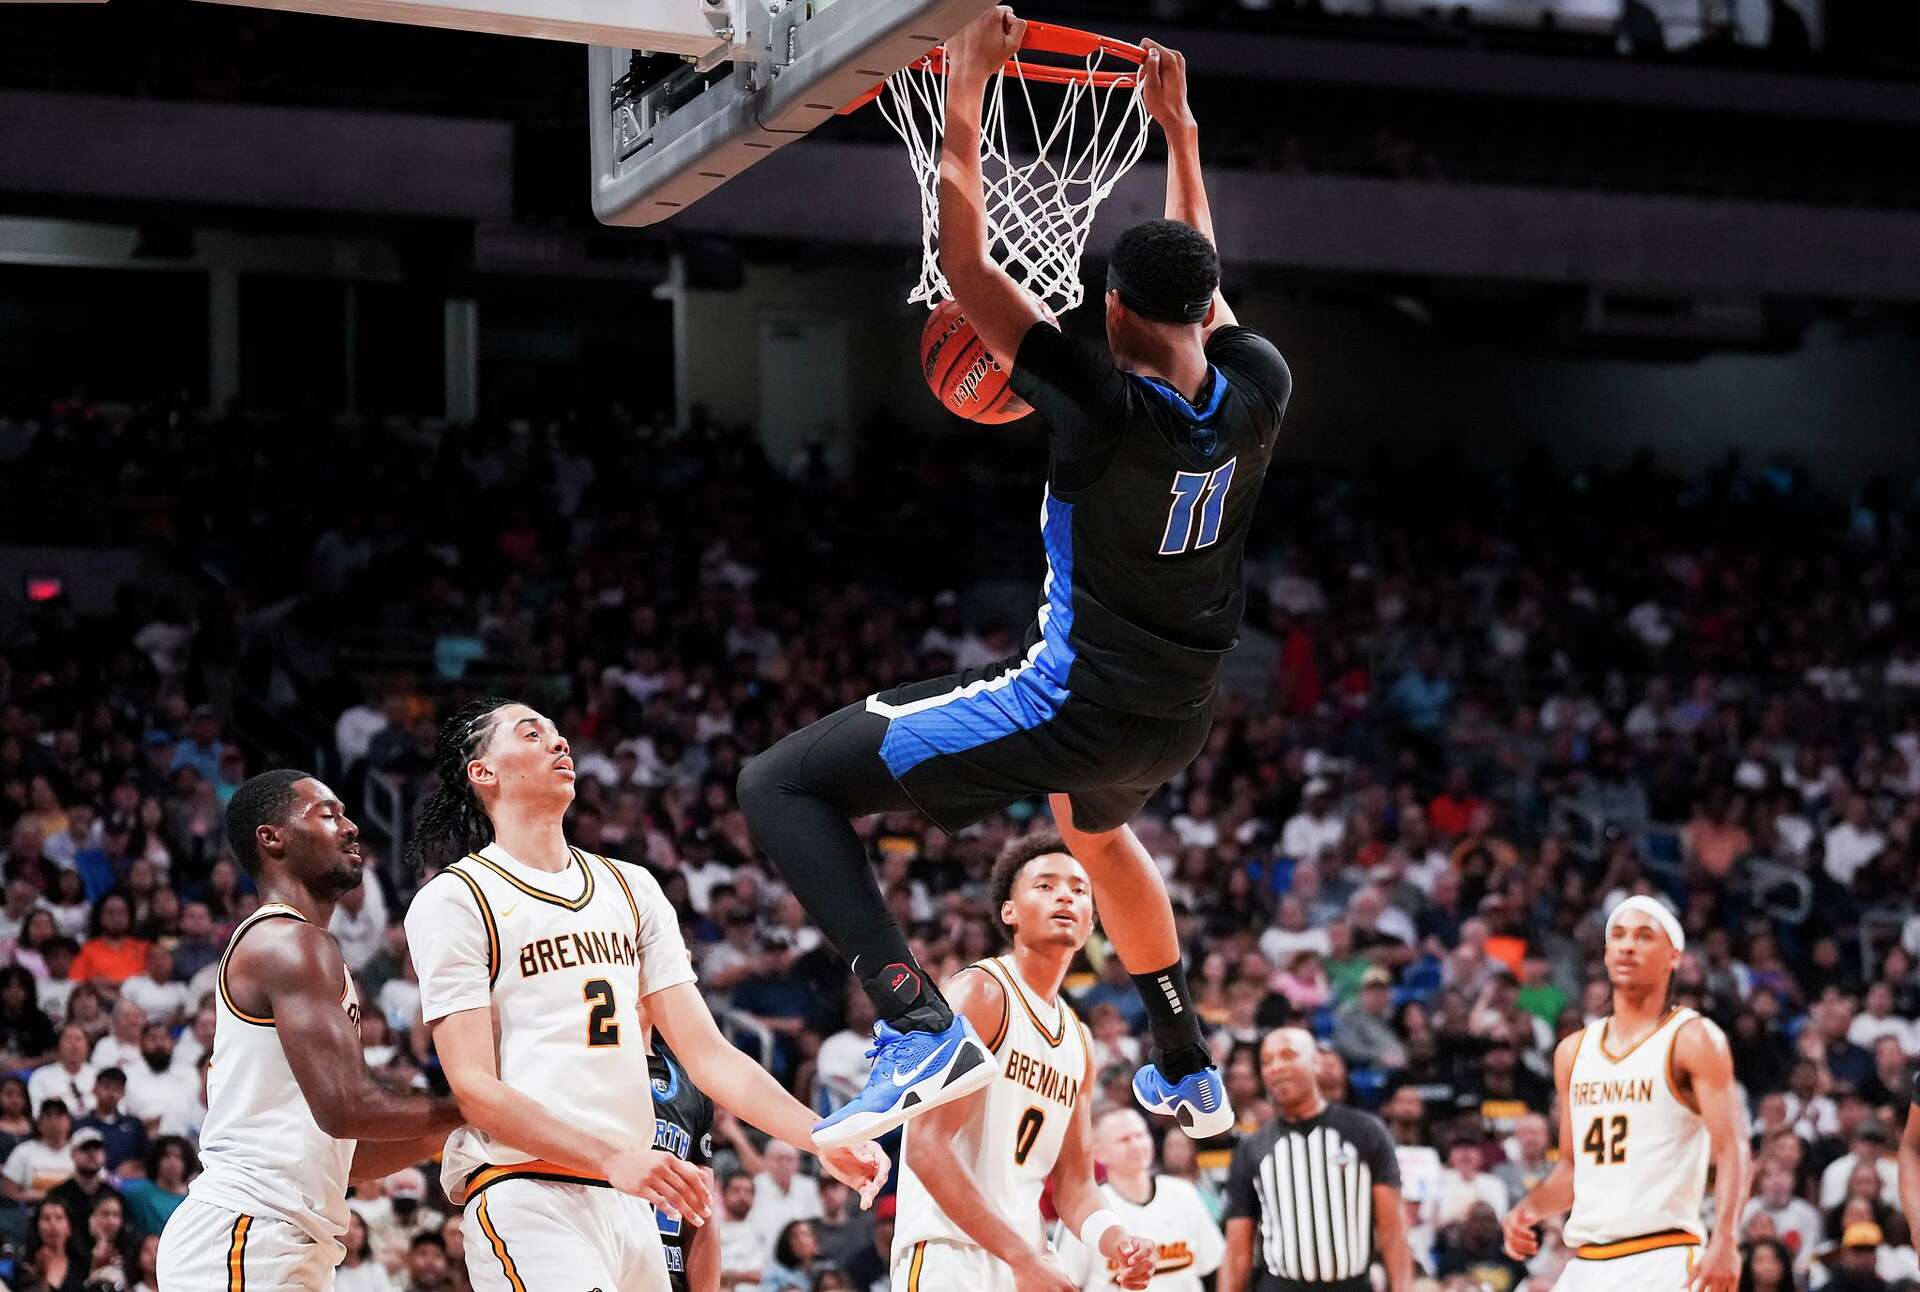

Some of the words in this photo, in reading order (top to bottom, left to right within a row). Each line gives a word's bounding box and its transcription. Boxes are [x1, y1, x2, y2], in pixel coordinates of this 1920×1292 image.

[949, 351, 1002, 408] Baden
[1158, 456, 1237, 555] 11
[519, 931, 636, 978] BRENNAN
[582, 977, 621, 1048] 2
[1004, 1049, 1078, 1109] BRENNAN
[655, 1118, 691, 1161] RTH
[1014, 1105, 1046, 1168] 0
[1583, 1114, 1630, 1166] 42
